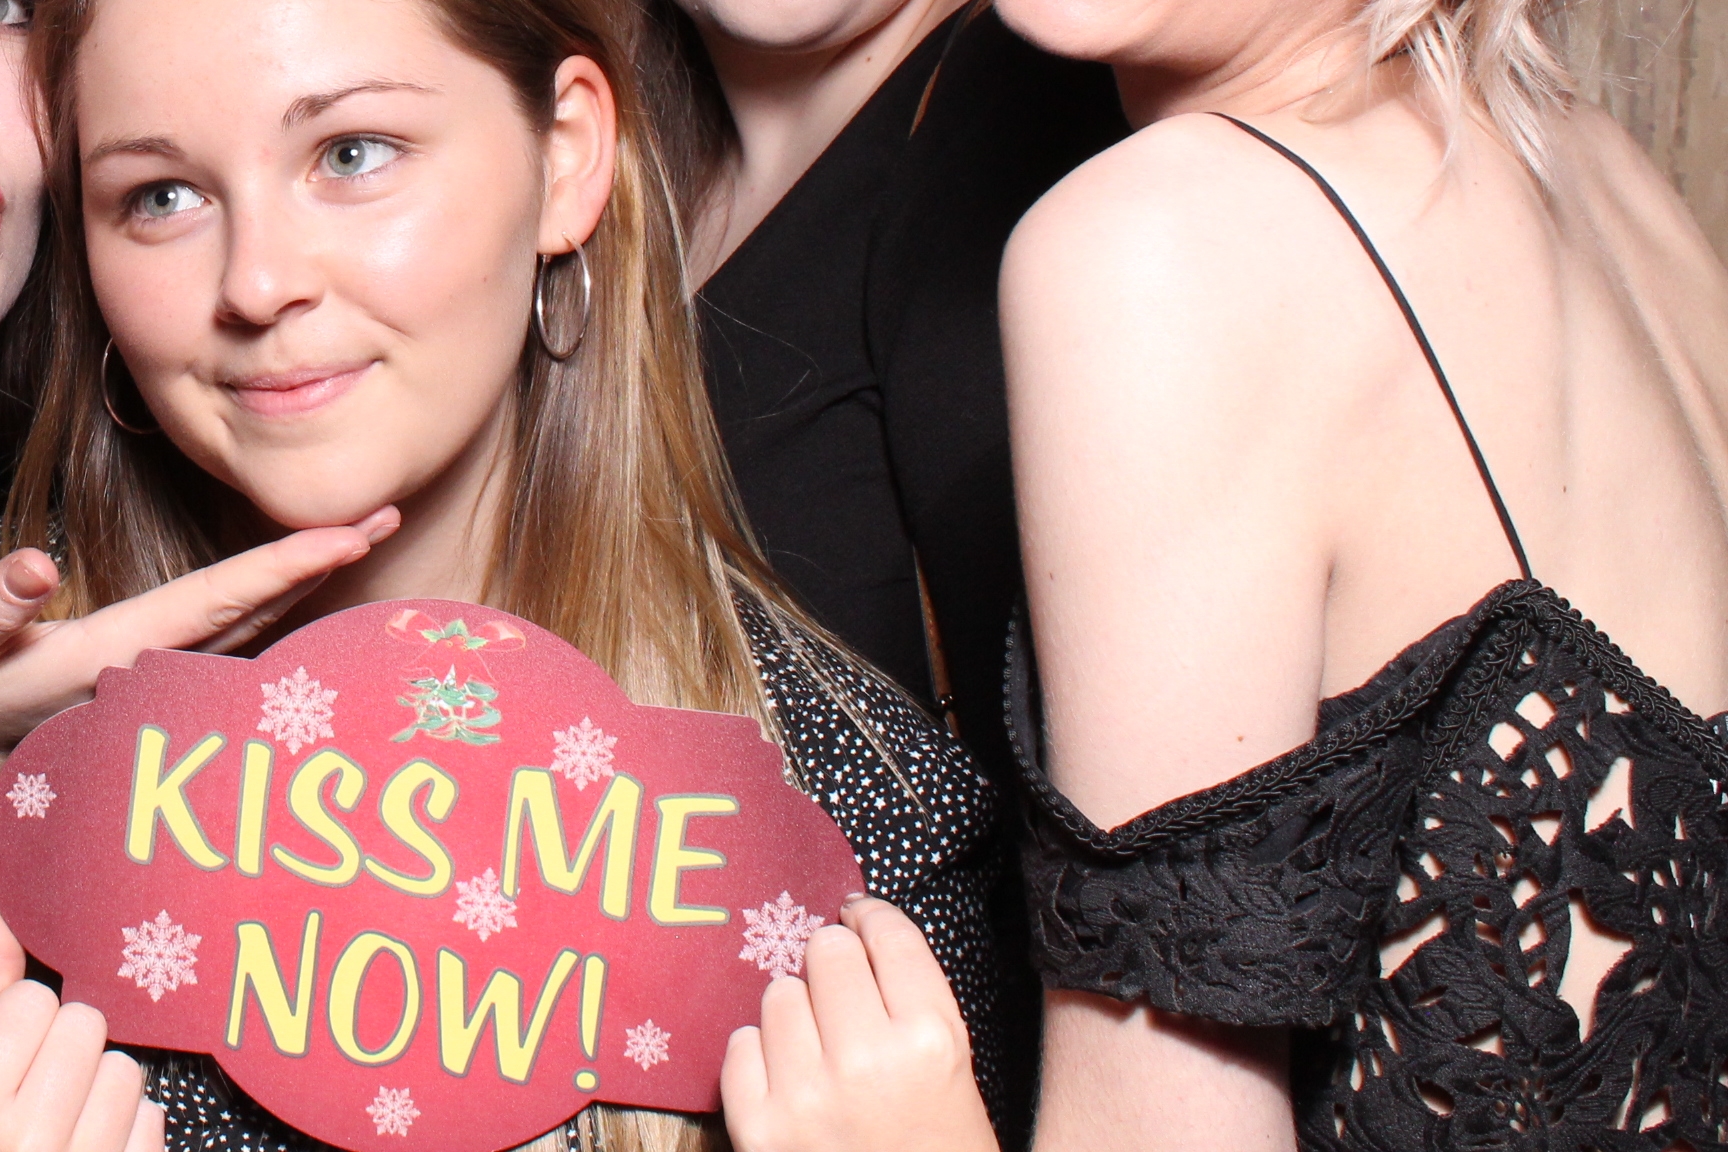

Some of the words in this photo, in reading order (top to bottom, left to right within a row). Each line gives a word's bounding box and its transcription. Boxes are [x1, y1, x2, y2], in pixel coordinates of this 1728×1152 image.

[126, 725, 458, 897] KISS
[500, 767, 739, 926] ME
[225, 910, 608, 1092] NOW!
